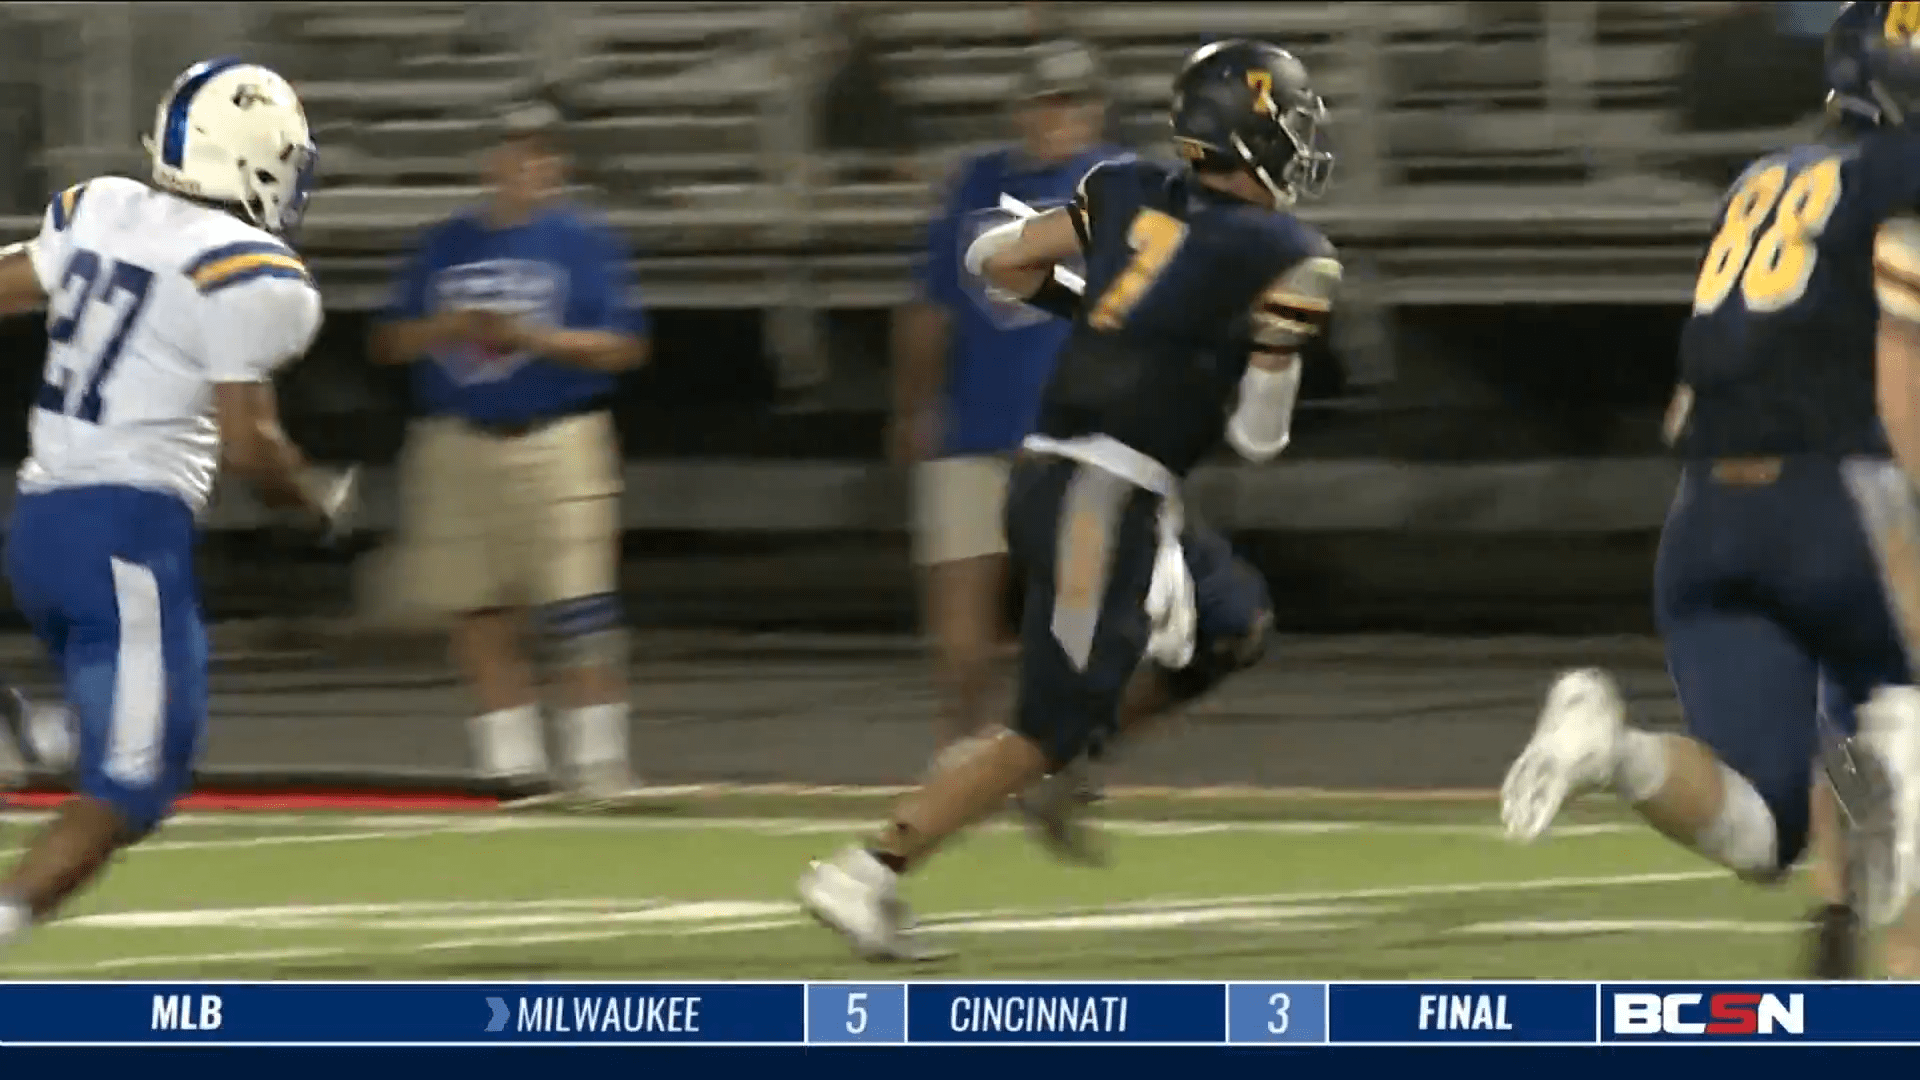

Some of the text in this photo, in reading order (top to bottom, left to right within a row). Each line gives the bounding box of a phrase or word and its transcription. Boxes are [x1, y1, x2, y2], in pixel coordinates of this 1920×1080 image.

[1246, 68, 1274, 114] 7
[1088, 206, 1190, 329] 7
[1693, 158, 1842, 316] 88
[37, 248, 155, 425] 27
